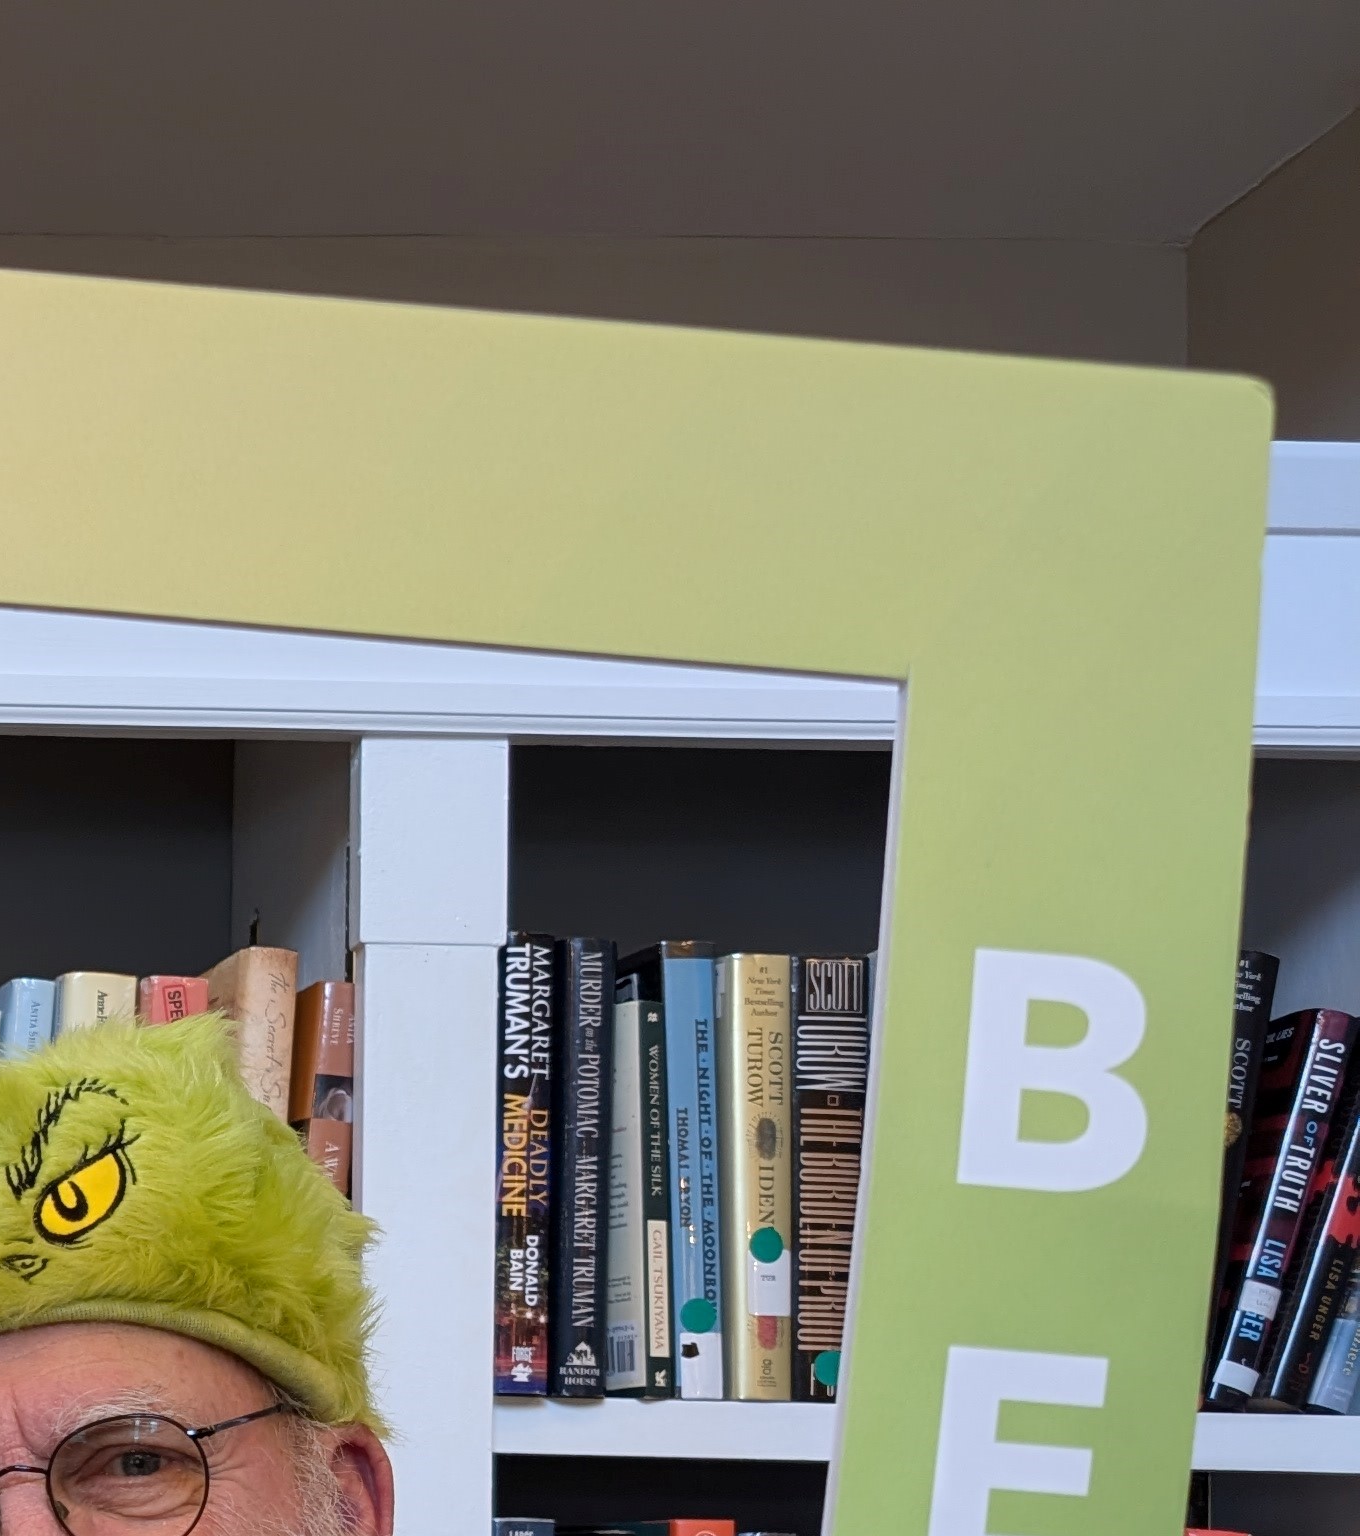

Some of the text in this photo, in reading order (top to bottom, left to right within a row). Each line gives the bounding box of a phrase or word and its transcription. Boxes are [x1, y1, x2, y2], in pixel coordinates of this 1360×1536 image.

[504, 944, 530, 1079] TRUMAN'S
[531, 944, 551, 1081] MARGARET
[797, 963, 866, 1092] SCOTT TUROW
[747, 1028, 763, 1108] TUROW
[769, 1030, 784, 1108] SCOTT
[1229, 1038, 1250, 1109] SCOTT
[503, 1094, 527, 1218] MEDICINE
[529, 1108, 549, 1207] DEADLY
[1274, 1038, 1345, 1213] SLIVER OF TRUTH
[510, 1248, 524, 1291] BAIN
[525, 1234, 538, 1306] DONALD
[572, 1146, 597, 1329] MARGARET TRUMAN
[652, 1229, 663, 1351] GAIL TSUKIYAMA
[560, 1366, 599, 1376] RANDOM
[565, 1376, 596, 1386] HOUSE
